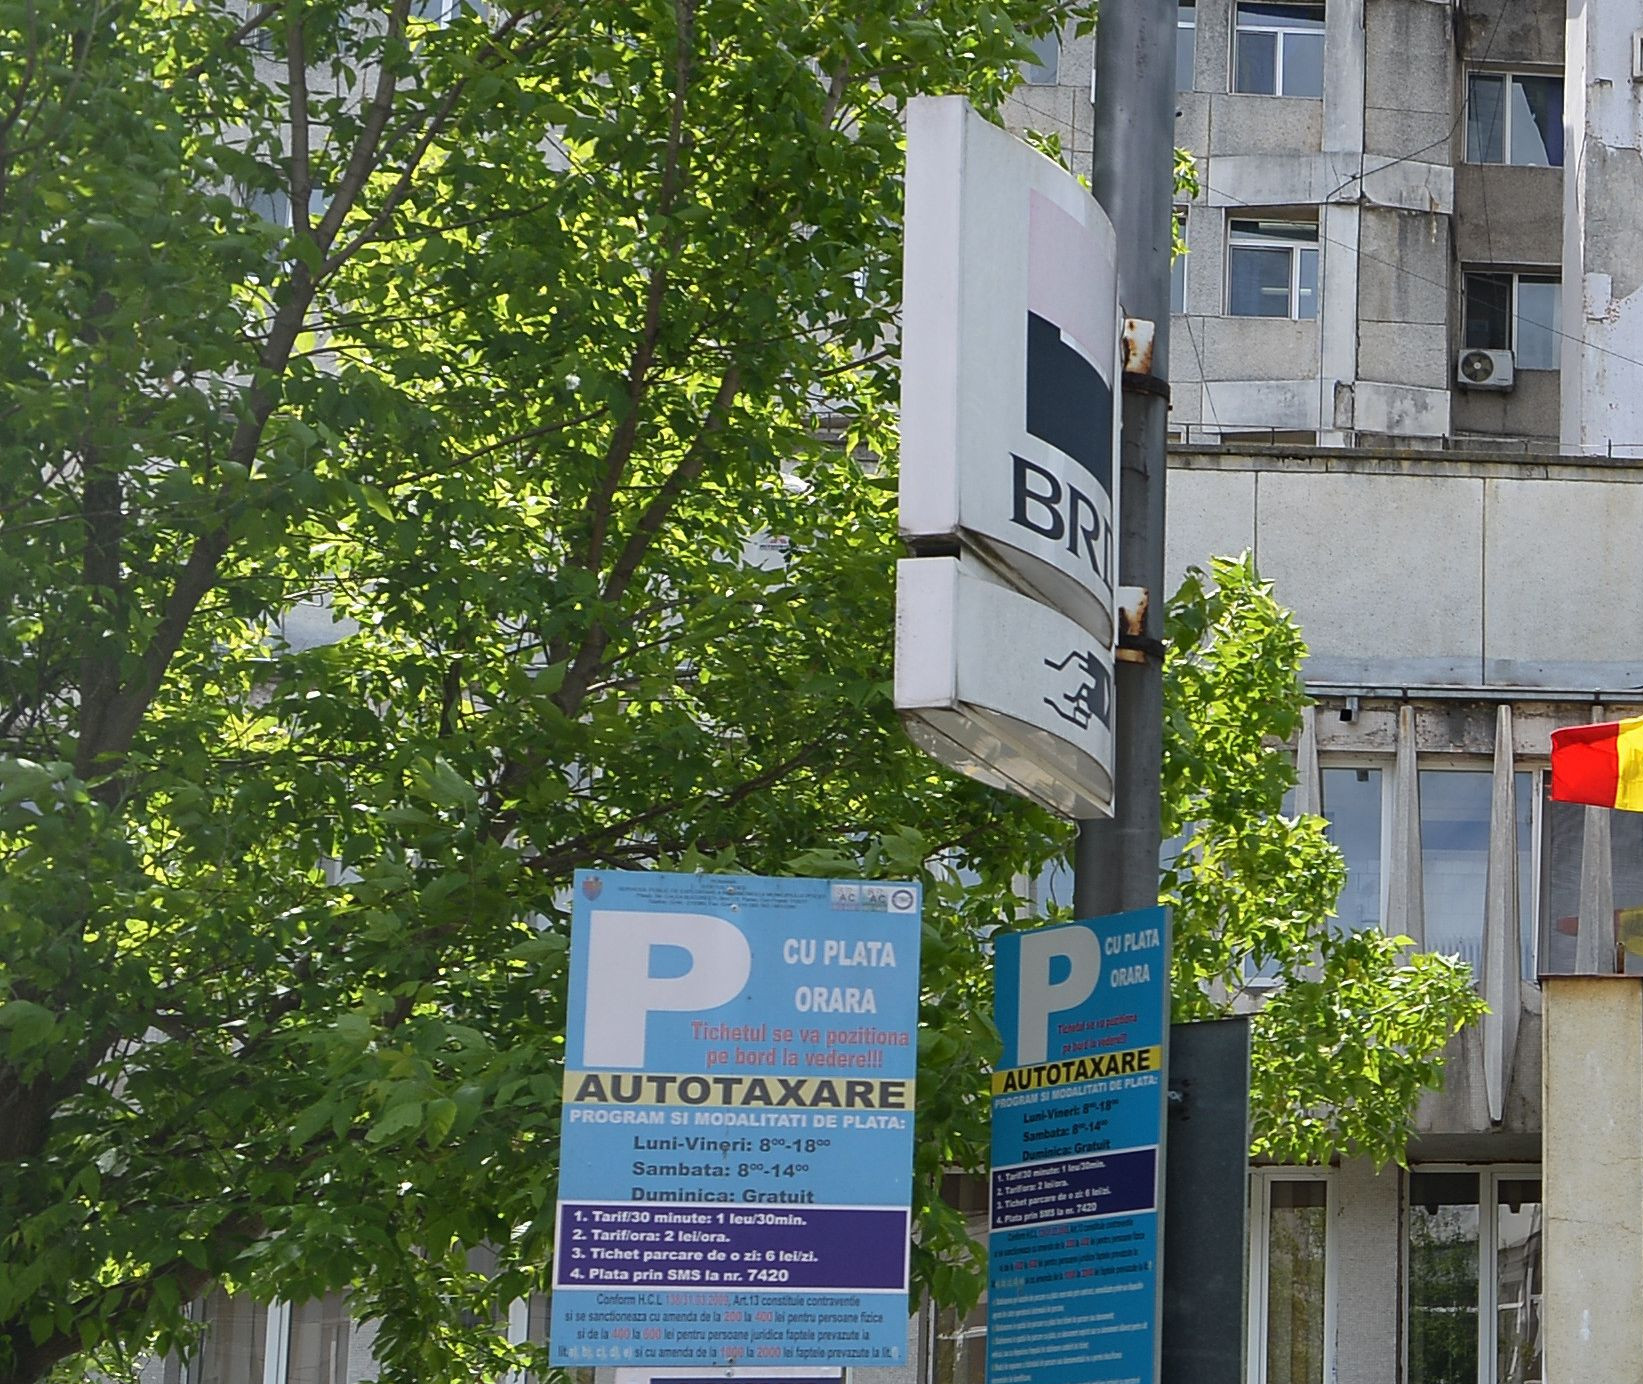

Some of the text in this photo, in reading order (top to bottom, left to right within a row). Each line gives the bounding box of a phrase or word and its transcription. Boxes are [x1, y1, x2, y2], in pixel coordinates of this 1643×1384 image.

[1105, 929, 1160, 955] CU PLATA
[783, 938, 897, 968] CU PLATA
[1110, 964, 1150, 988] ORARA
[583, 910, 751, 1068] P
[1018, 925, 1101, 1066] P
[795, 986, 877, 1014] ORARA
[691, 1020, 910, 1051] Tichetul se va pozitiona
[706, 1046, 883, 1068] pe bord la vedere!!!
[1003, 1049, 1151, 1093] AUTOTAXARE
[574, 1074, 906, 1109] AUTOTAXARE
[994, 1092, 1038, 1109] PROGRAM
[1051, 1082, 1107, 1100] MODALITATI
[1110, 1081, 1123, 1091] DE
[1125, 1075, 1158, 1090] PLATA:
[569, 1109, 906, 1130] PROGRAM SI MODALITATI DE PLATA:
[1023, 1107, 1080, 1124] Luni-Vineri:
[633, 1135, 752, 1153] Luni-Vineri:
[1023, 1128, 1070, 1142] Sambata:
[1074, 1139, 1111, 1155] Gratuit
[632, 1161, 731, 1177] Sambata:
[630, 1187, 814, 1204] Duminica: Gratuit
[574, 1211, 588, 1222] 1.
[592, 1210, 650, 1224] Tarif/30
[654, 1212, 712, 1225] minute:
[716, 1213, 725, 1225] 1
[571, 1229, 587, 1242] 2.
[592, 1229, 660, 1242] Tarif/ora:
[664, 1230, 674, 1242] 2
[571, 1248, 587, 1260] 3.
[590, 1248, 640, 1260] Tichet
[643, 1250, 703, 1264] parcare
[707, 1249, 726, 1261] de
[730, 1252, 740, 1262] o
[766, 1250, 776, 1262] 6
[570, 1268, 789, 1283] 4. Plata prin SMS la nr. 7420
